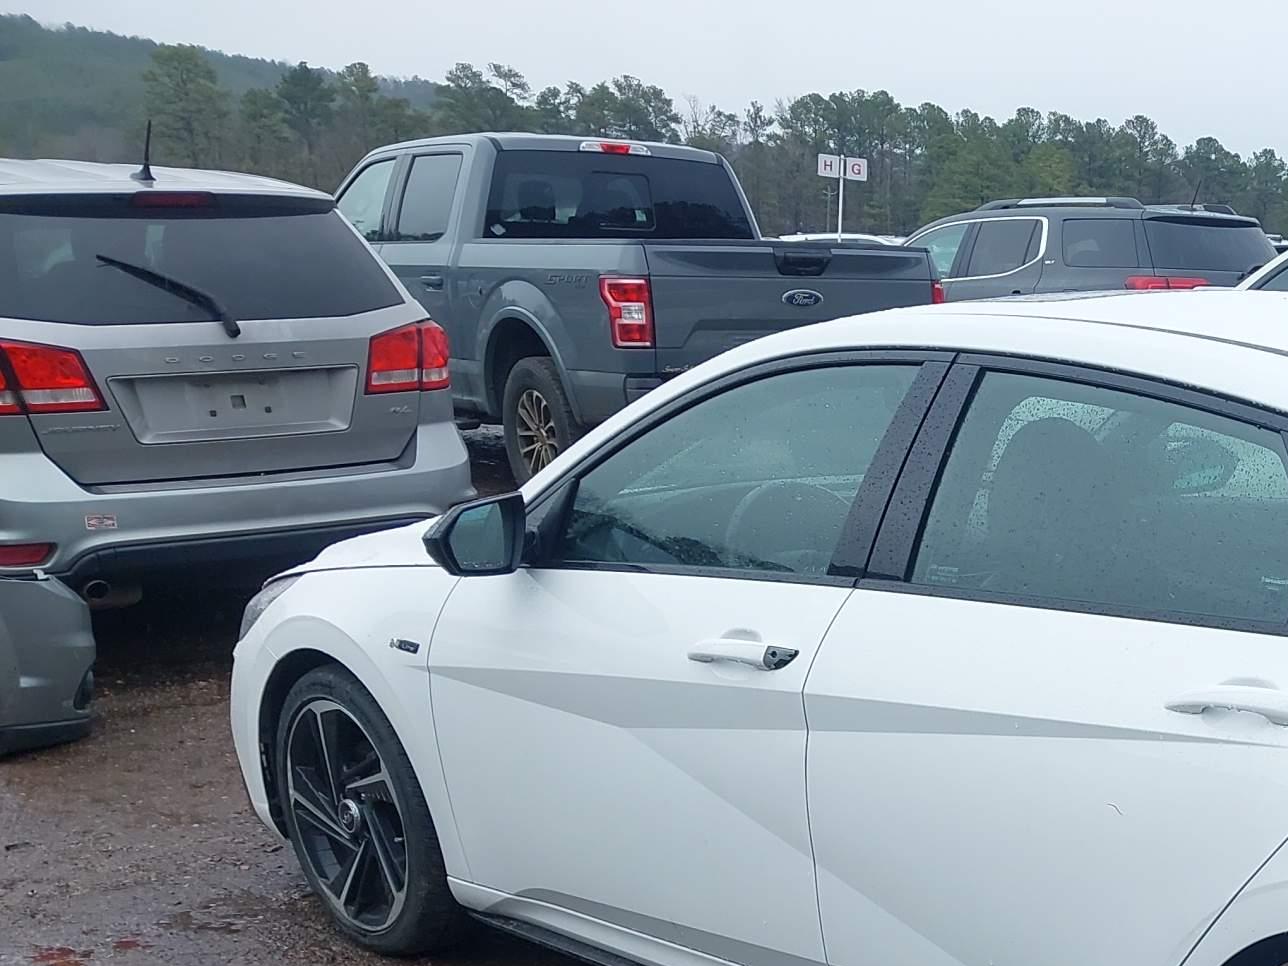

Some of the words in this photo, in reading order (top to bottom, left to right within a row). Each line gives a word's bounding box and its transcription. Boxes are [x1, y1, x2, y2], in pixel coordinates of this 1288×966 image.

[823, 159, 833, 172] H
[851, 163, 862, 175] G
[792, 292, 816, 305] Ford
[164, 351, 306, 364] DODGE
